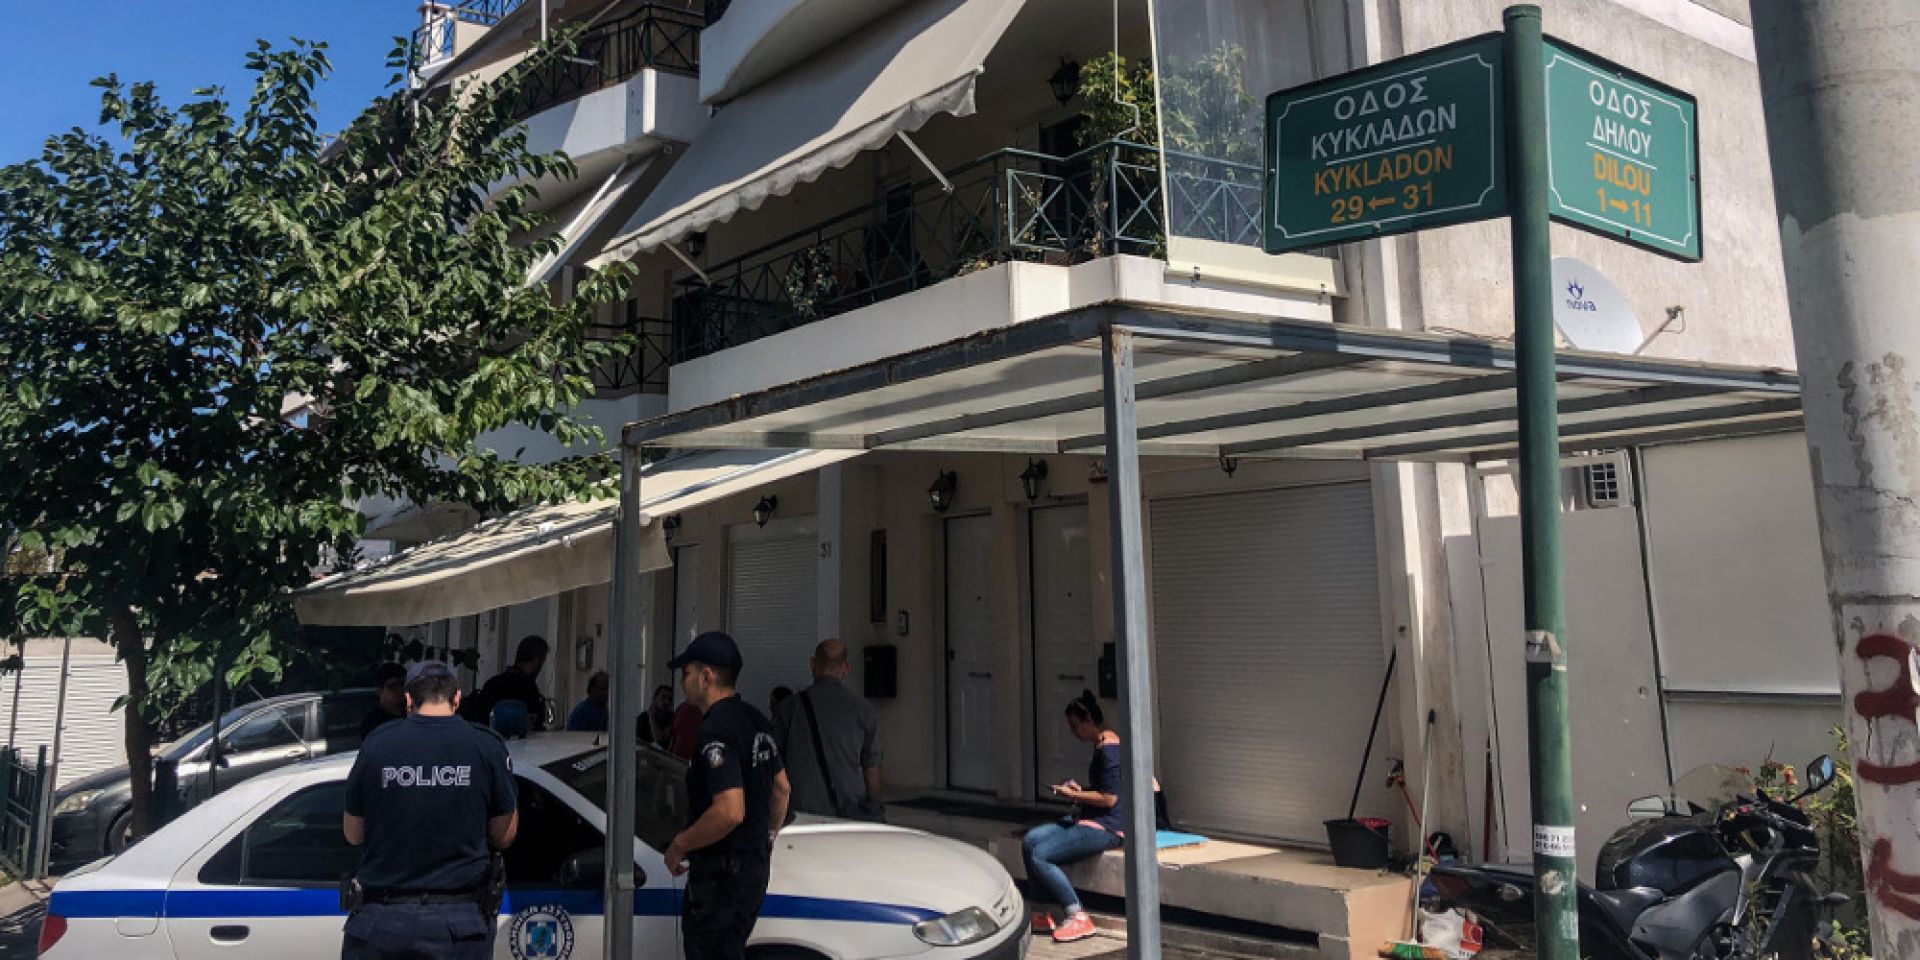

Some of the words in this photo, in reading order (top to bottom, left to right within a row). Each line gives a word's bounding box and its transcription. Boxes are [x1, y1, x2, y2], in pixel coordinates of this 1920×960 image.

[1334, 76, 1429, 120] ΟΔΟΣ
[1589, 80, 1652, 126] ΟΔΟΣ
[1311, 103, 1457, 160] ΚΥΚΛΑΔΩΝ
[1593, 115, 1652, 158] ΔΗΛΟΥ
[1314, 144, 1453, 196] KYKLADON
[1594, 153, 1650, 196] DILOU
[1330, 195, 1364, 224] 29
[1402, 180, 1433, 210] 31
[1566, 299, 1596, 312] nova
[382, 765, 471, 788] POLICE
